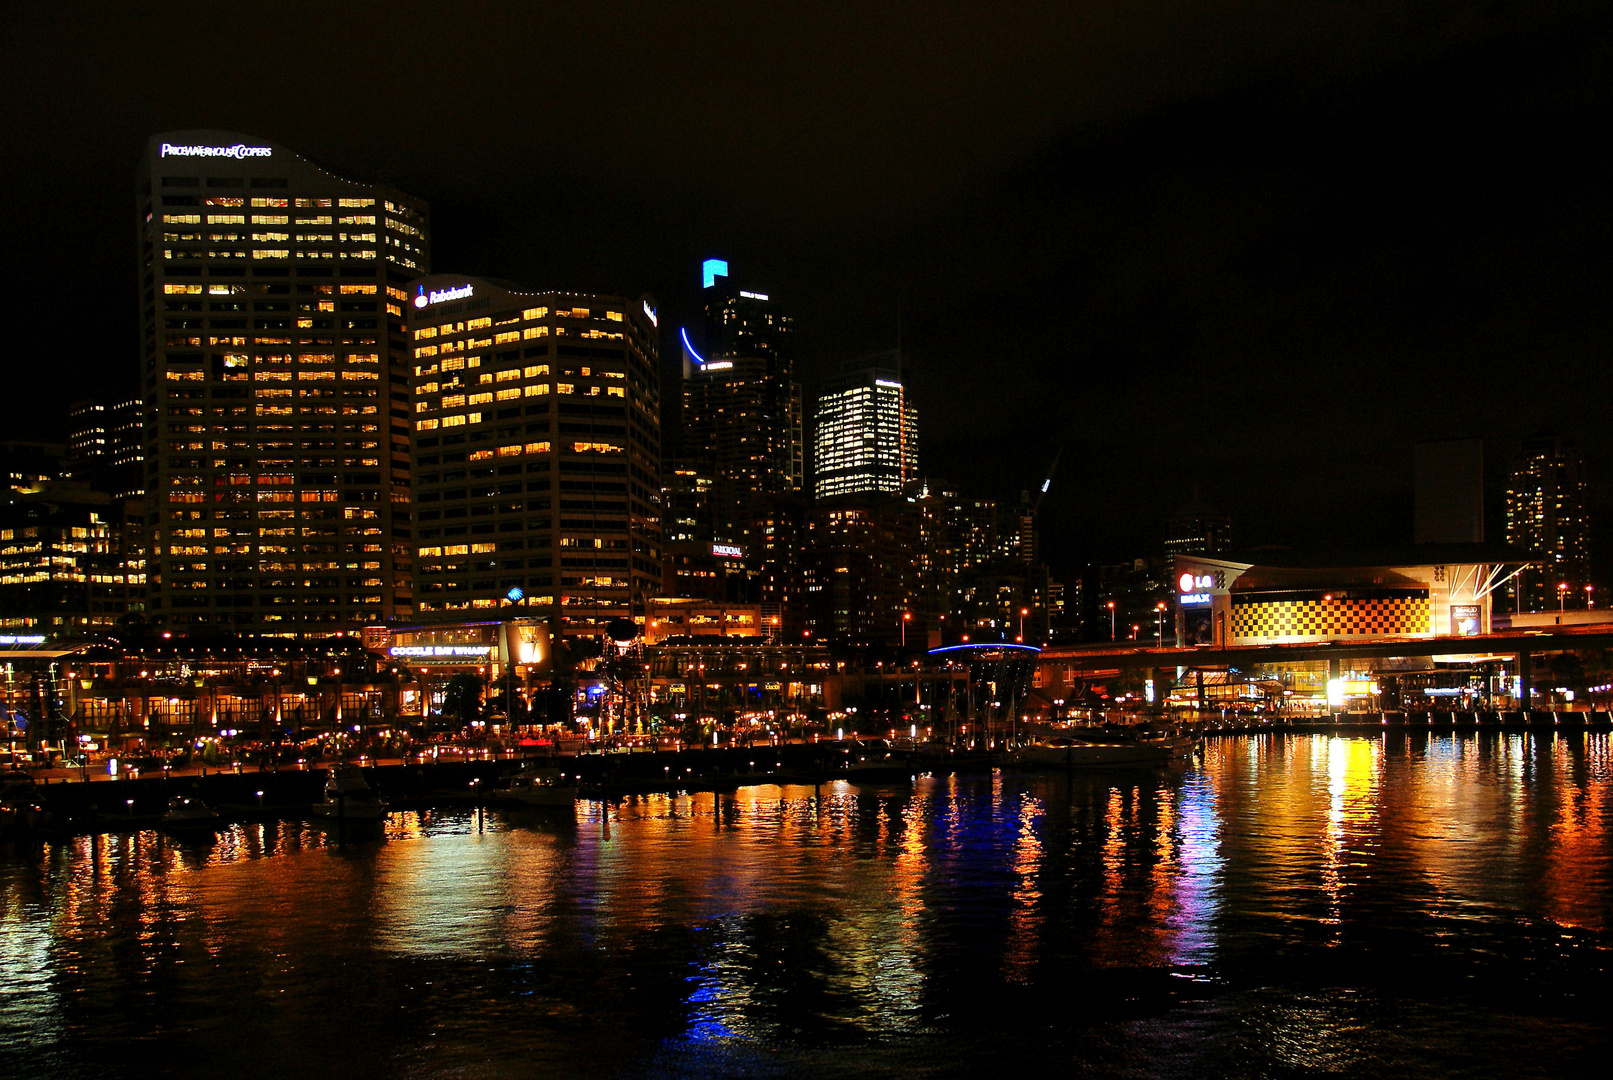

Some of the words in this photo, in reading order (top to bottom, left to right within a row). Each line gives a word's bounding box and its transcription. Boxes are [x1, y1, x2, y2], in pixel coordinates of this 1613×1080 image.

[428, 284, 473, 304] Rabobank
[1195, 575, 1212, 588] LG
[1180, 594, 1210, 604] IMAX
[390, 646, 433, 656] COCKLE
[434, 646, 453, 655] BAY
[454, 646, 490, 655] WHARF
